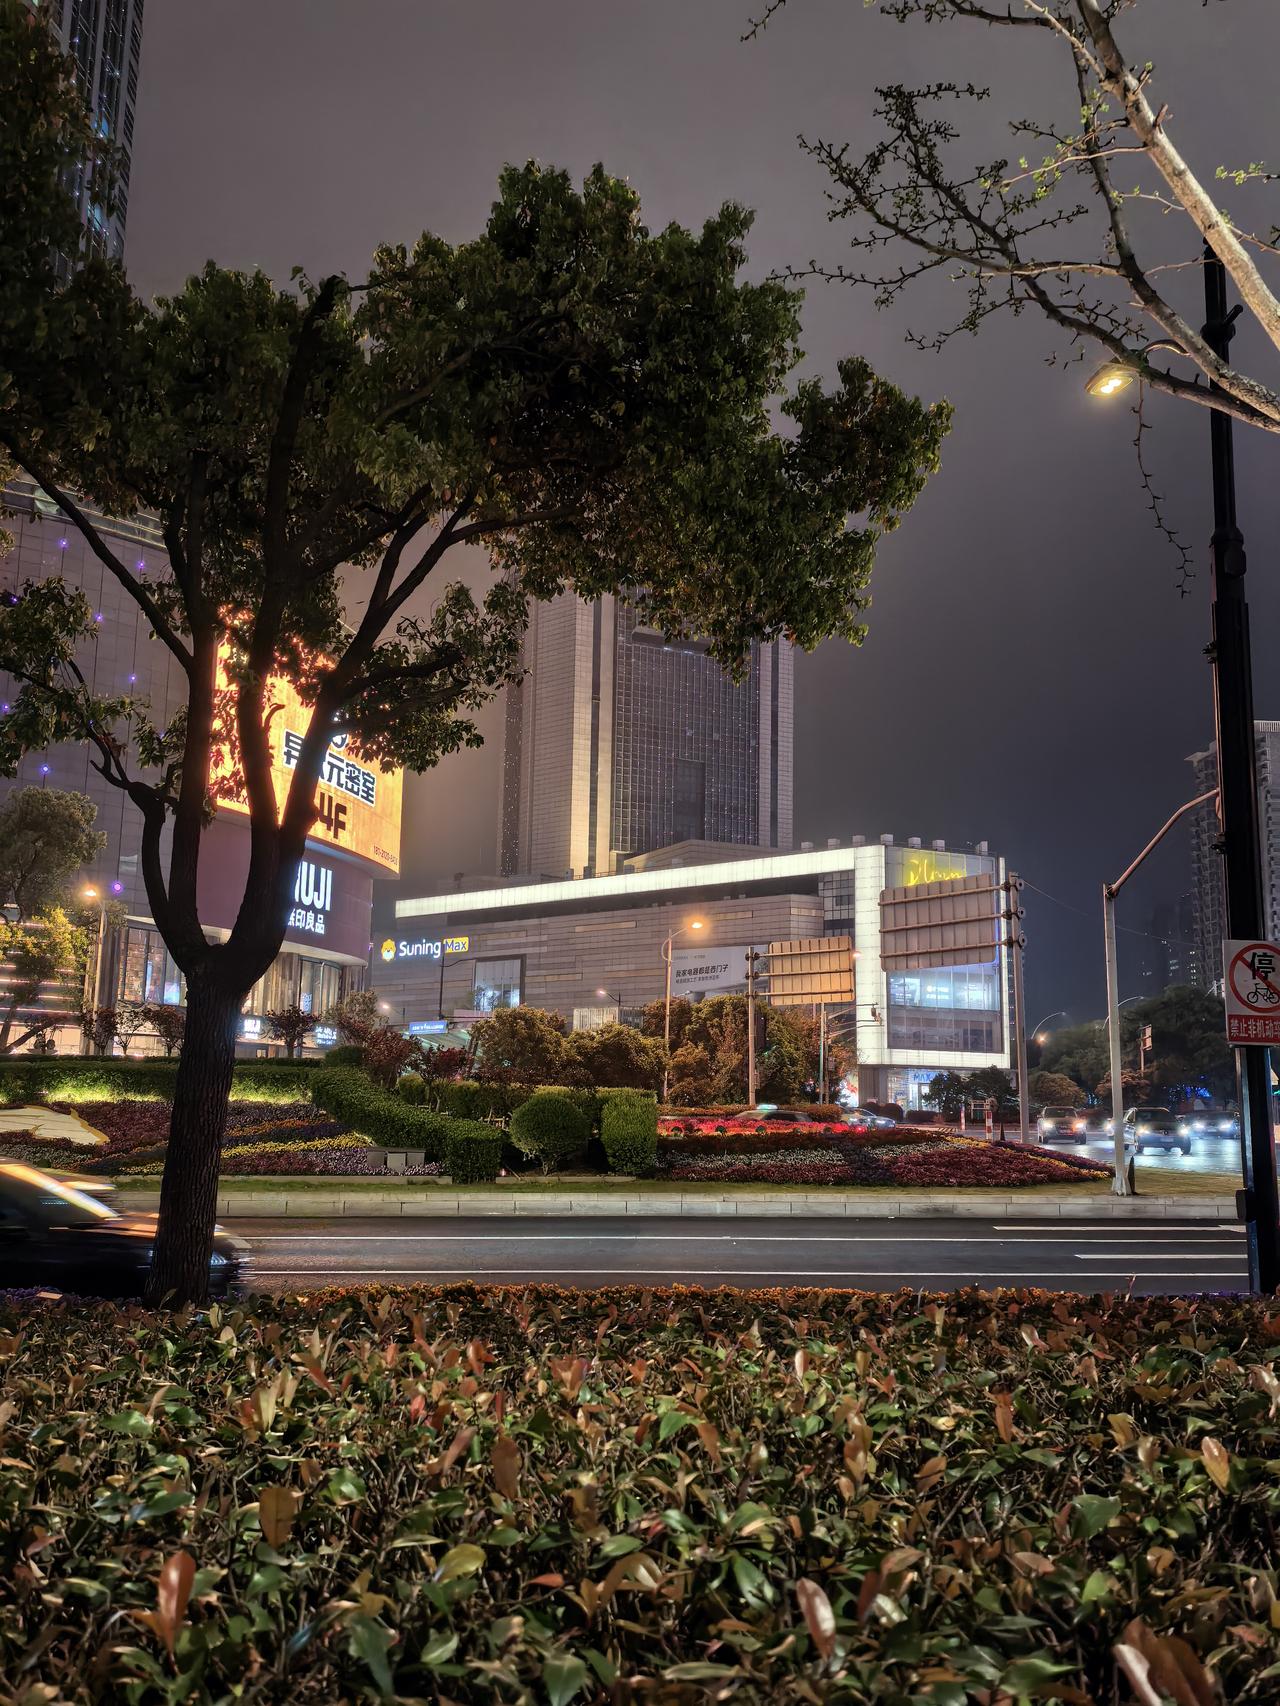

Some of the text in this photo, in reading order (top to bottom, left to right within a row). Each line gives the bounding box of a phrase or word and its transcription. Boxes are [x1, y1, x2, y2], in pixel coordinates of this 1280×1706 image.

[284, 731, 376, 804] 异元密室
[318, 791, 347, 839] 4F
[399, 939, 467, 958] Suning Max
[1249, 951, 1276, 981] 停
[1230, 1017, 1280, 1038] 禁止非机动车
